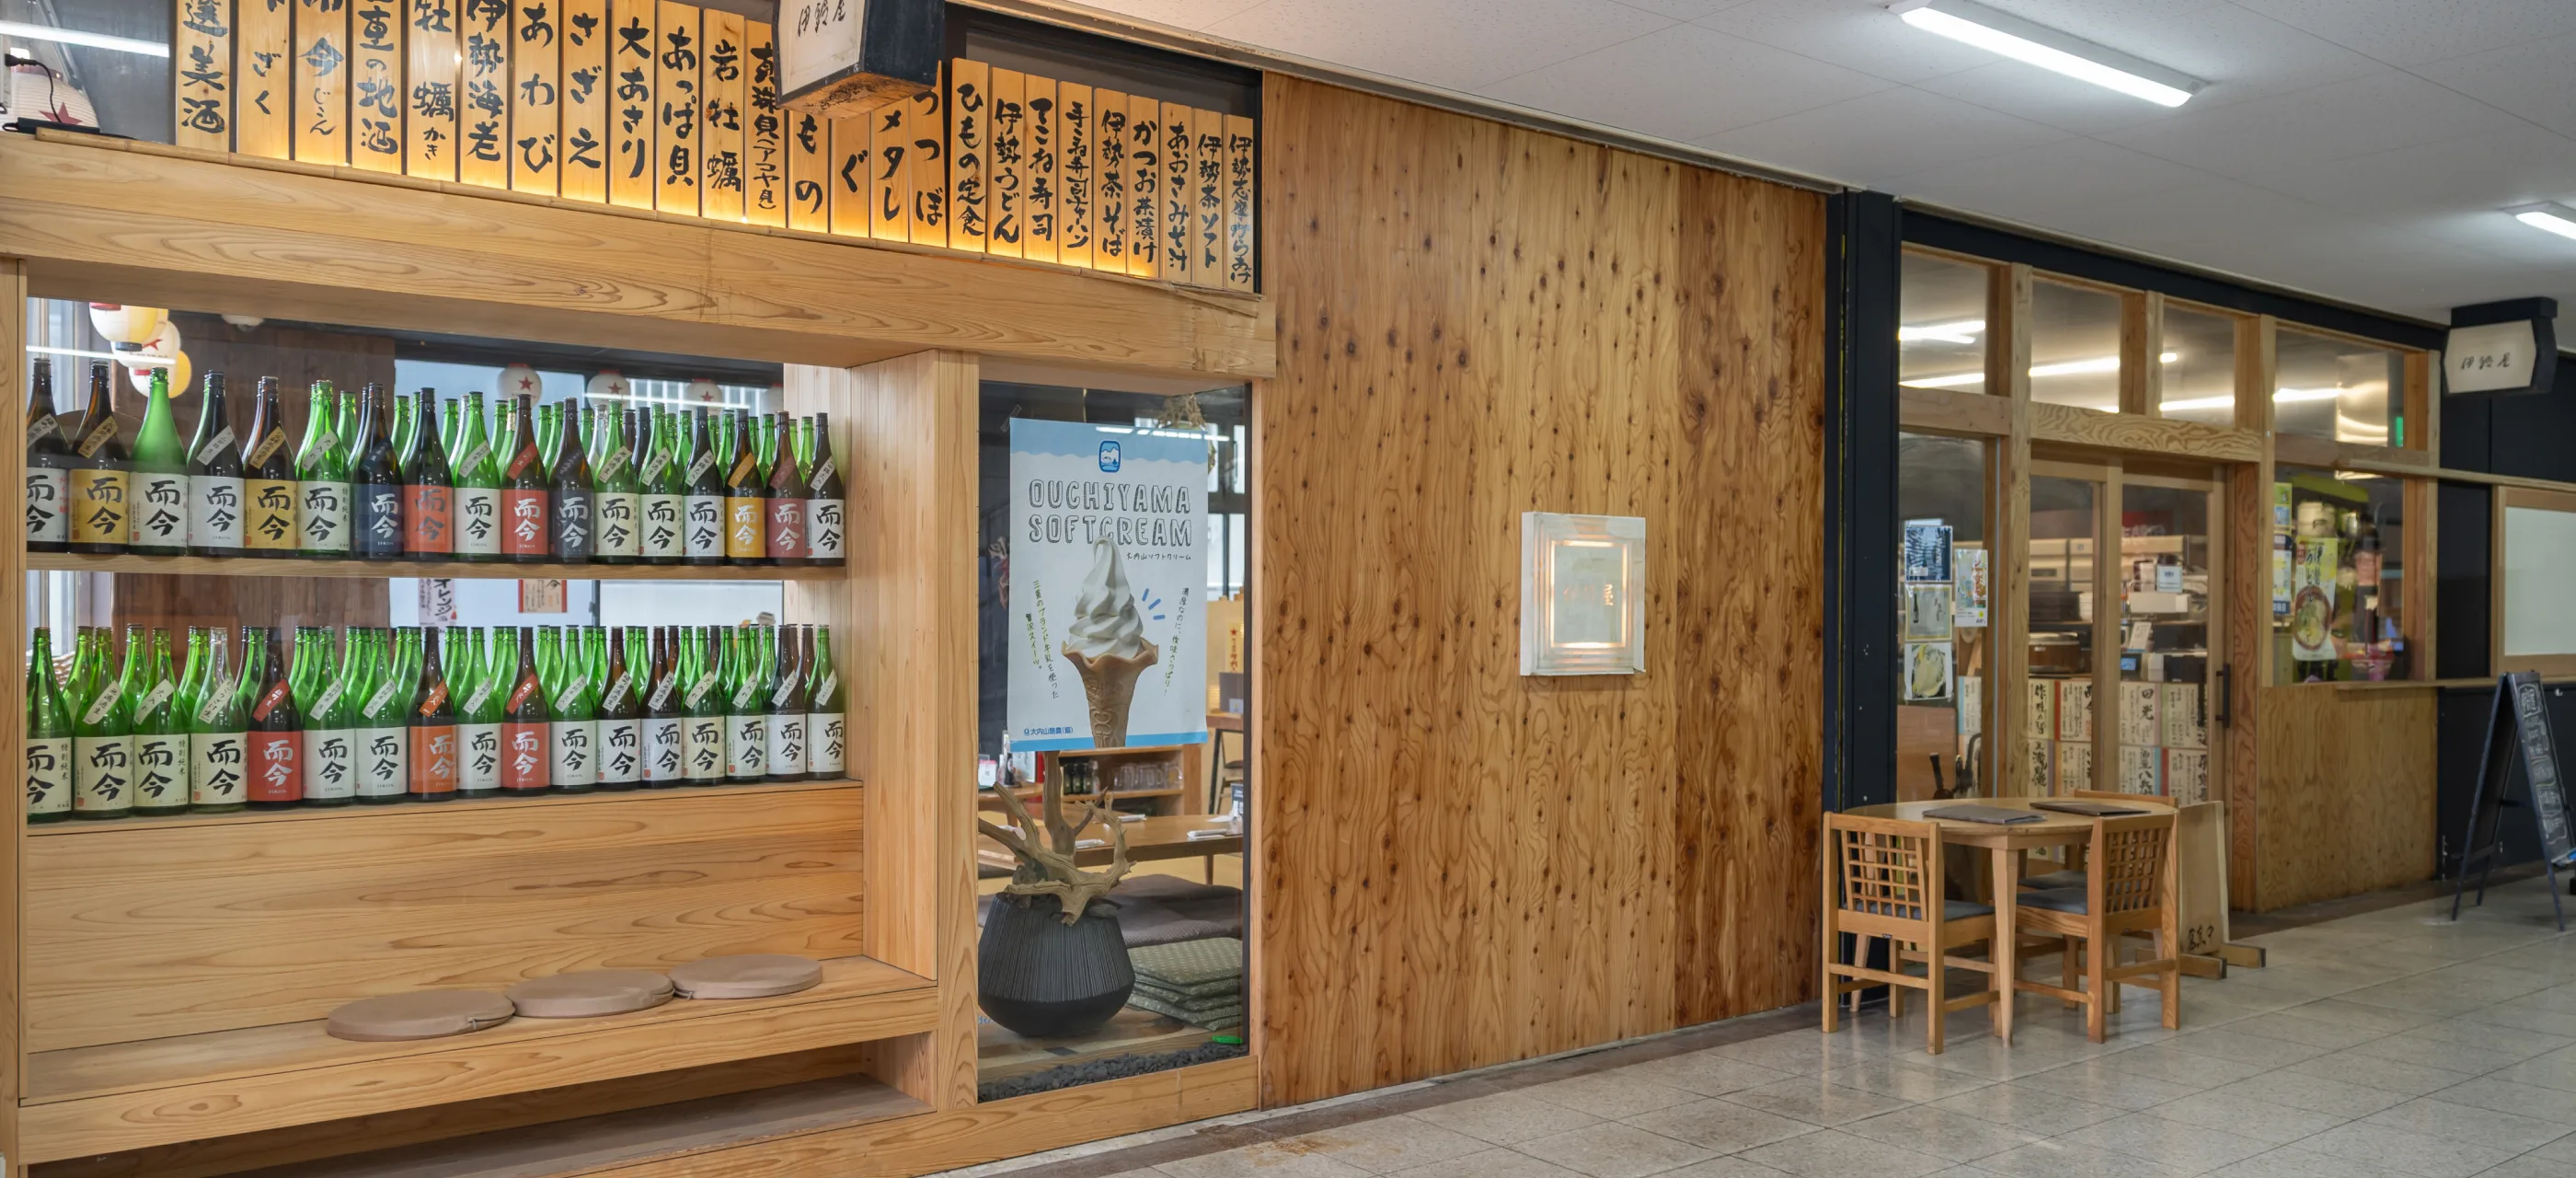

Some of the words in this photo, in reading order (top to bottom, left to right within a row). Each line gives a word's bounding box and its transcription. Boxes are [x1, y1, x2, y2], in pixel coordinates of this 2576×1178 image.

[252, 0, 284, 115] ざく
[356, 0, 398, 155] 重の地酒
[466, 0, 507, 162] 伊勢海老
[517, 2, 556, 174] あわび
[569, 12, 603, 168] さざえ
[617, 17, 651, 179] 大あさり
[661, 26, 696, 186] あっぱ貝
[707, 39, 742, 192] 岩牡蠣
[957, 83, 986, 237] ひもの定食
[994, 98, 1022, 244] 伊勢うどん
[1029, 98, 1053, 241] てこね寿司
[1101, 109, 1126, 257] 伊勢茶そば
[1133, 120, 1157, 263] かつお茶漬け
[1167, 121, 1190, 271] あおさみそ汁
[1196, 133, 1222, 268] 伊勢茶ソフト
[27, 475, 54, 534] 而今
[86, 477, 122, 535] 而今
[144, 480, 180, 537] 而今
[206, 486, 236, 532] 而今
[258, 486, 291, 540] 而今
[305, 487, 338, 541] 而今
[371, 493, 398, 539] 而今
[415, 489, 445, 541] 而今
[465, 496, 492, 539] 而今
[513, 498, 540, 542] 而今
[1029, 479, 1191, 514] OUCHIYAMA
[558, 497, 589, 549] 而今
[602, 498, 630, 549] 而今
[648, 500, 675, 549] 而今
[690, 501, 718, 550] 而今
[734, 504, 758, 546] 而今
[775, 503, 800, 551] 而今
[816, 504, 841, 552] 而今
[1029, 514, 1192, 547] SOFTCREAM
[1126, 552, 1191, 560] 大内山ソフトクリーム
[1032, 580, 1060, 699] 三重のブランド牛乳を使った
[262, 739, 293, 787] 而今
[318, 738, 348, 784] 而今
[370, 735, 399, 780] 而今
[429, 734, 454, 779] 而今
[471, 732, 497, 775] 而今
[512, 731, 539, 775] 而今
[561, 728, 587, 771] 而今
[608, 725, 637, 776] 而今
[656, 723, 681, 773] 而今
[692, 722, 719, 771] 而今
[740, 721, 765, 769] 而今
[780, 722, 802, 762] 而今
[824, 721, 844, 760] 而今
[27, 745, 55, 804] 而今
[89, 743, 127, 802] 而今
[138, 741, 173, 799] 而今
[206, 739, 241, 796] 而今
